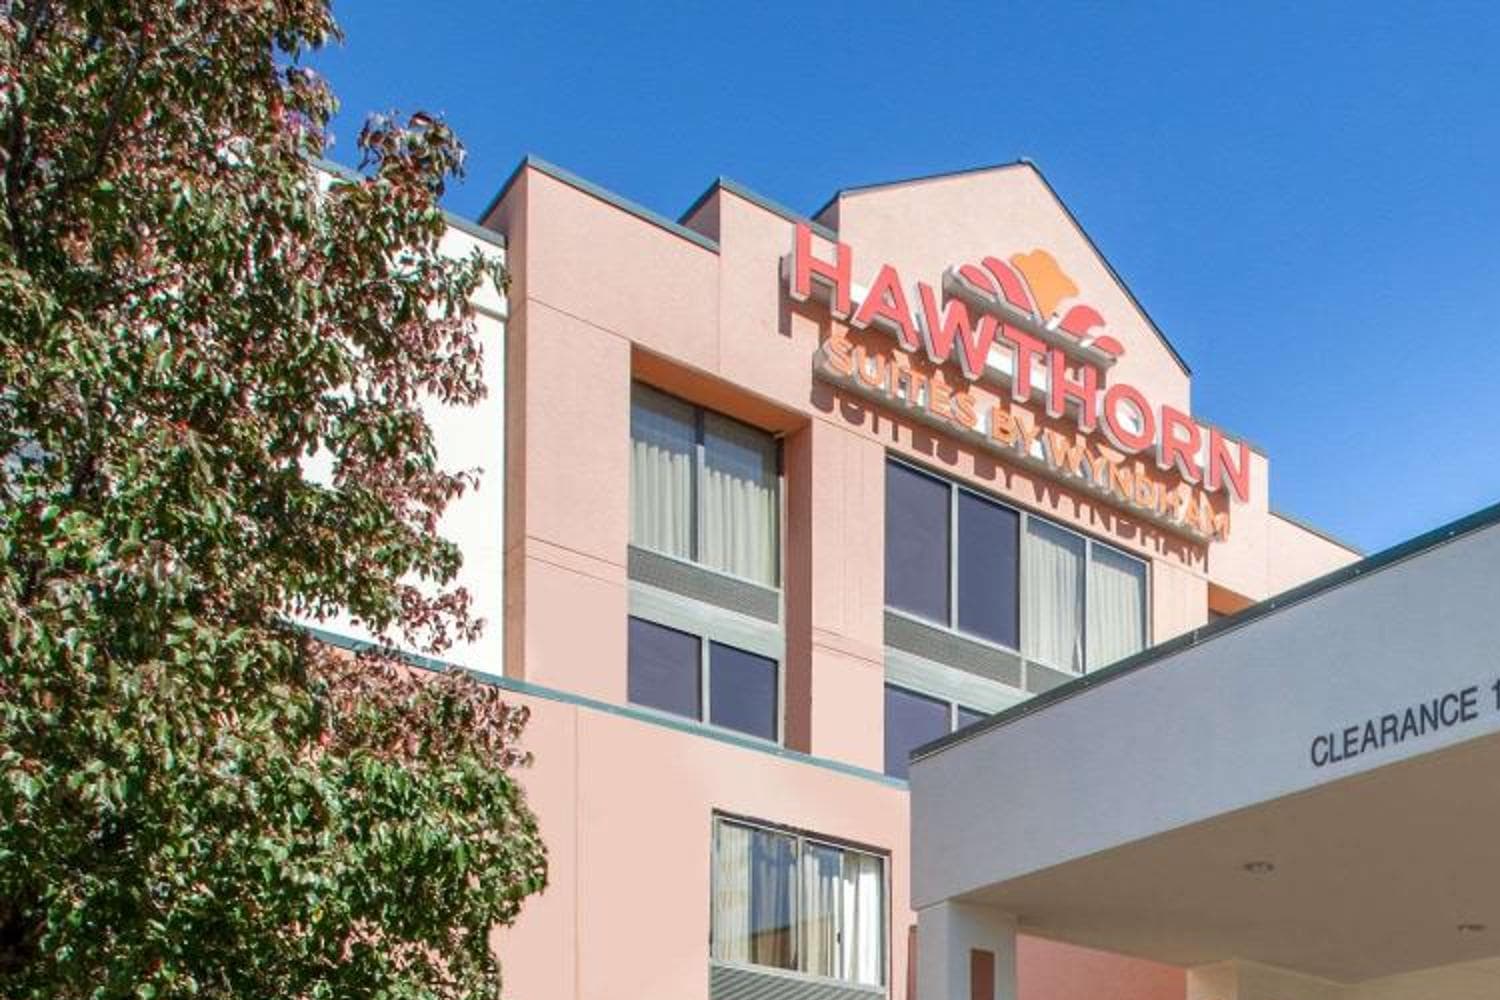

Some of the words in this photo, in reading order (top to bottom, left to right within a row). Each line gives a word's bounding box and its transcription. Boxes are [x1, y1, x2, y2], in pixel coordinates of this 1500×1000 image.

[789, 222, 1250, 502] HAWTHORN
[824, 332, 978, 432] SUITES
[988, 404, 1039, 459] BY
[1043, 428, 1231, 543] WYNDHAM
[1310, 685, 1479, 768] CLEARANCE
